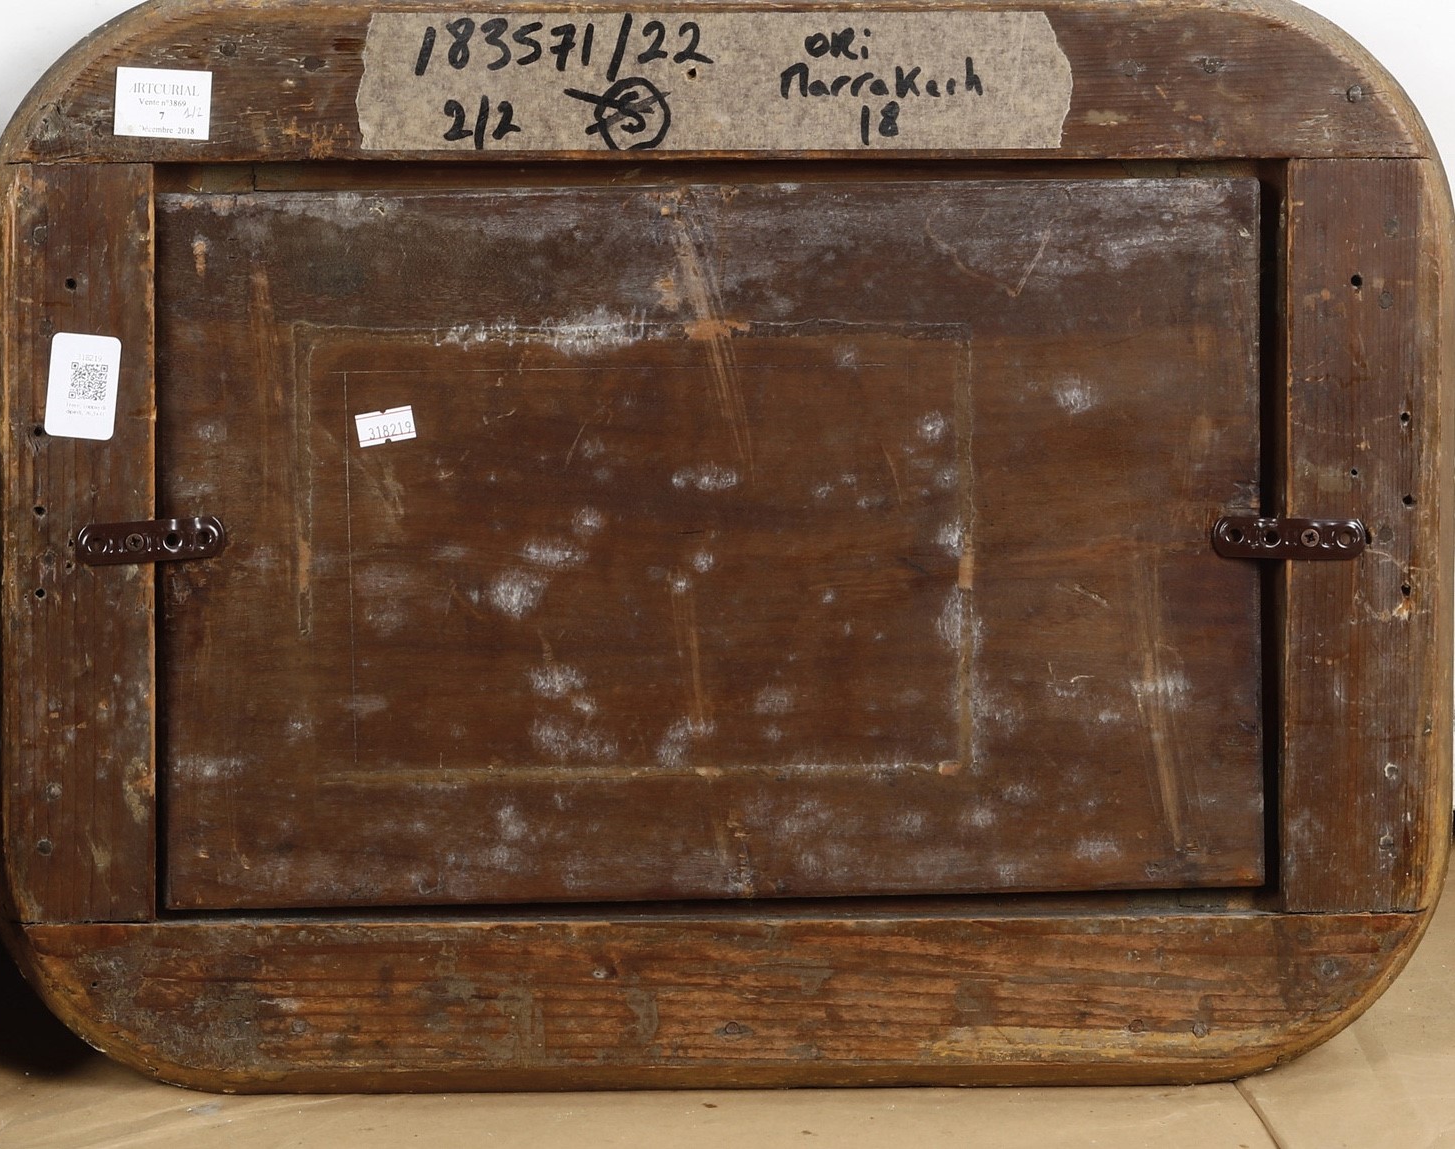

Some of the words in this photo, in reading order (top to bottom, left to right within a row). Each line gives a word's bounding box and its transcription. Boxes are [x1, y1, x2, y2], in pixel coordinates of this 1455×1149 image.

[415, 12, 715, 82] 183571/22
[129, 82, 200, 97] ARTCURIAL
[138, 97, 160, 106] Vente
[158, 111, 165, 120] 7
[443, 95, 522, 150] 2/2
[860, 100, 900, 146] 18
[177, 126, 195, 135] 2018
[368, 420, 412, 440] 318219
